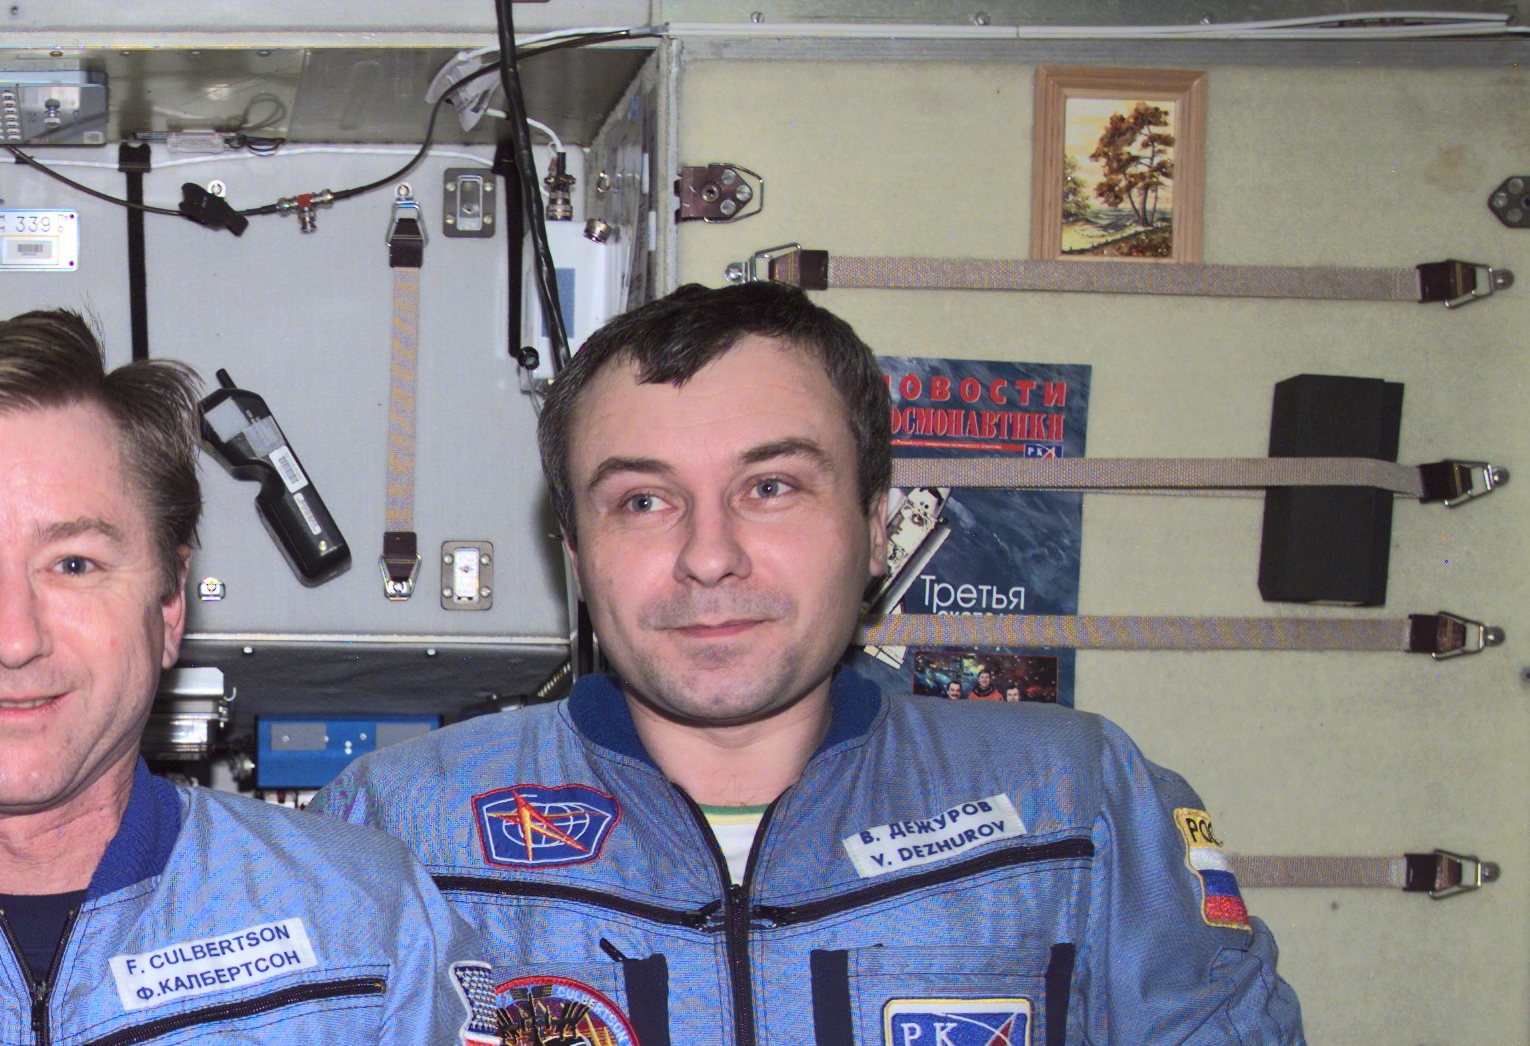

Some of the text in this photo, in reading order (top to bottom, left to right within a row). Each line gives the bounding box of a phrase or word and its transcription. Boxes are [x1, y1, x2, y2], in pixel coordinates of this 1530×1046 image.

[16, 216, 51, 233] 339
[920, 574, 1025, 614] Третья
[858, 801, 993, 845] В. ДЕЖУРОВ
[870, 820, 1005, 868] V. DEZHUROV
[126, 924, 290, 976] F. CULBERTSON
[136, 950, 301, 1001] Ф.КАЛБЕРТСОН
[556, 986, 628, 1042] CULBERTSON
